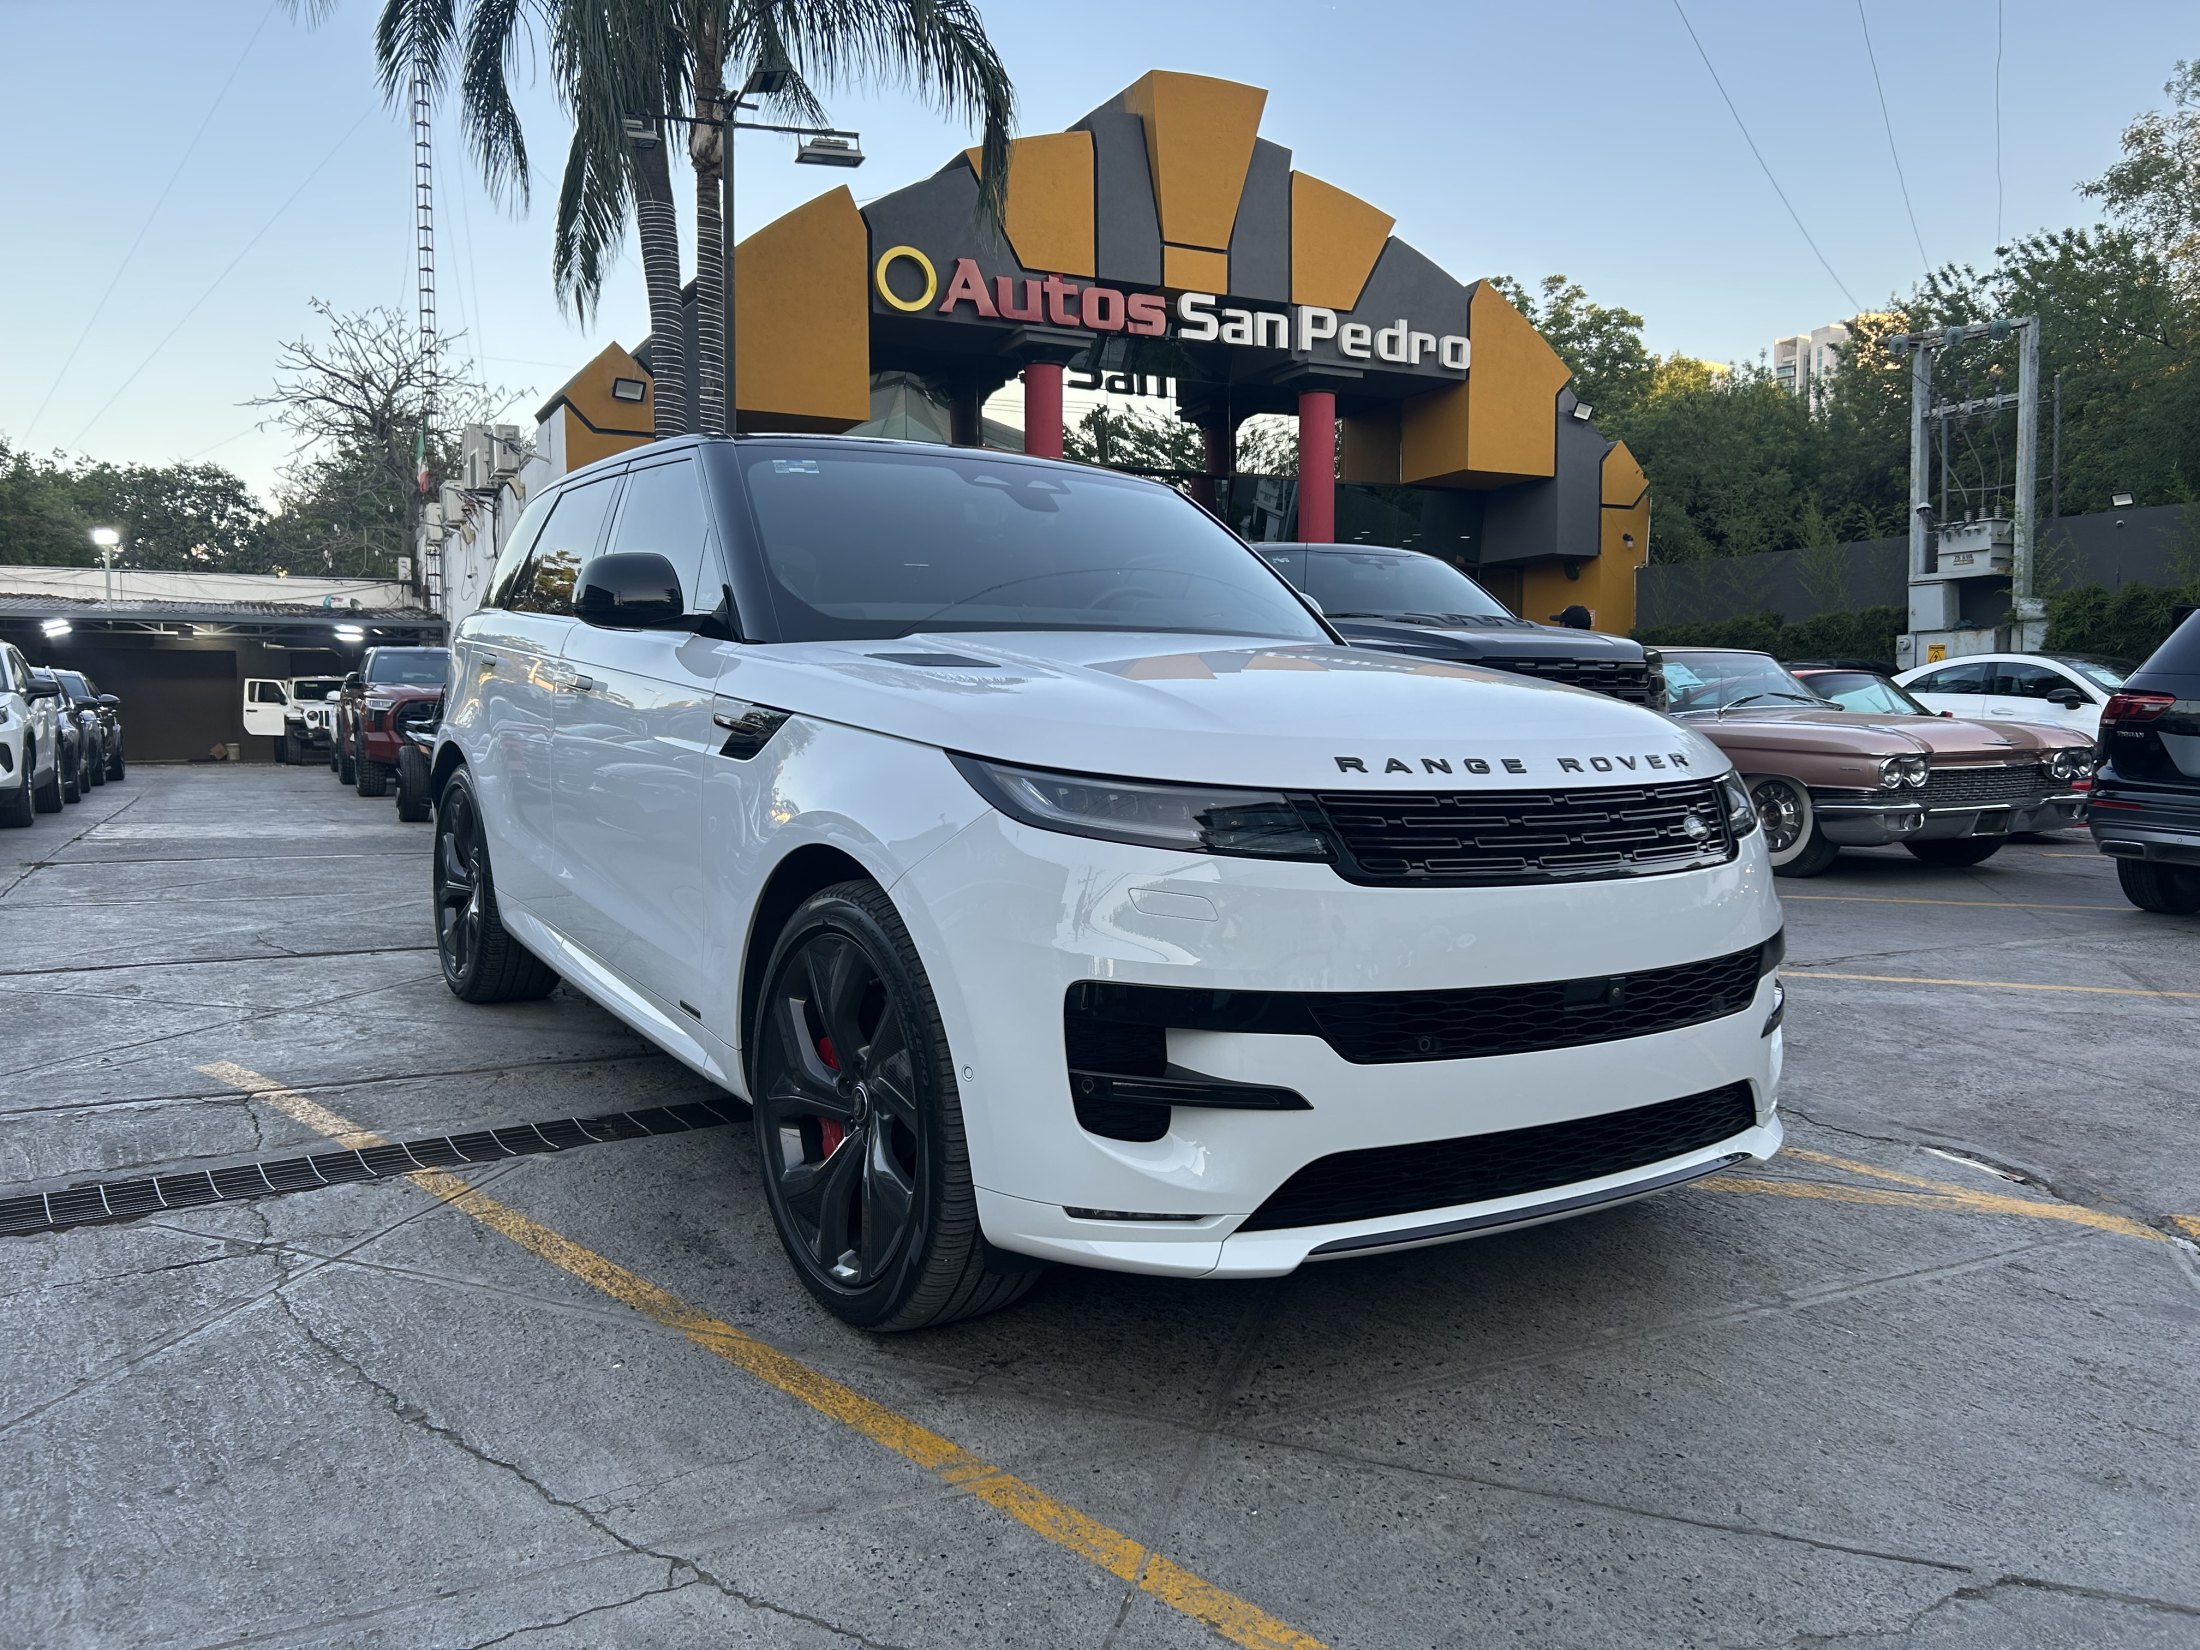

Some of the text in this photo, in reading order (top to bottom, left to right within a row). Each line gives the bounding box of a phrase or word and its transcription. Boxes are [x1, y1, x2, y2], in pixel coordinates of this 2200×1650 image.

[938, 257, 1167, 336] Autos
[1334, 753, 1690, 774] RANGE ROVER
